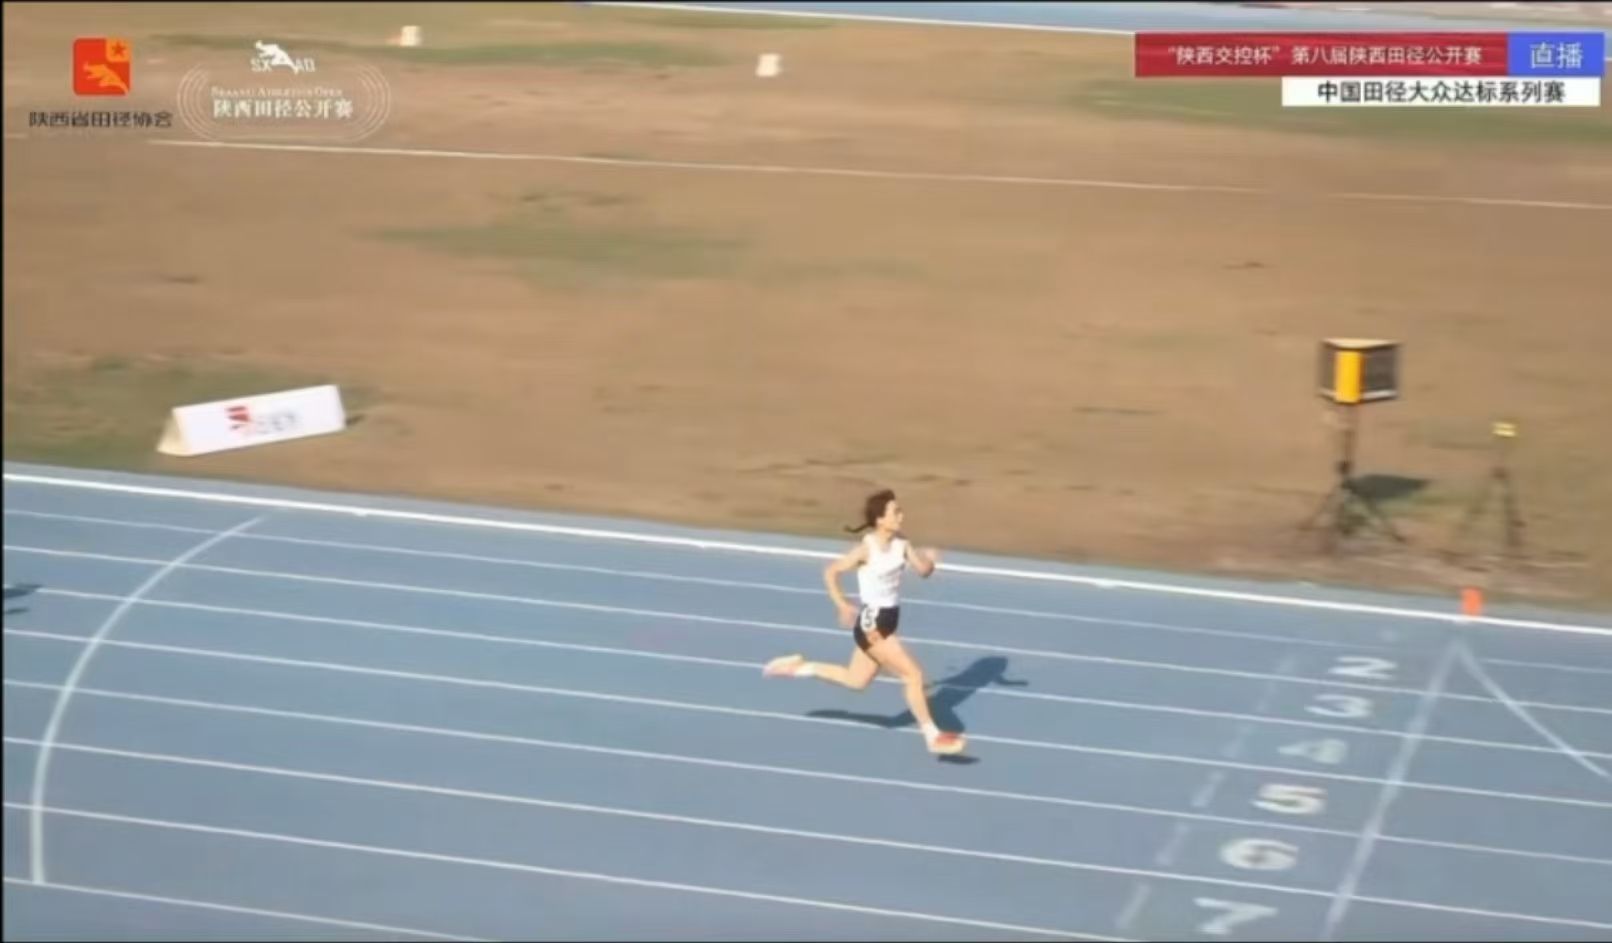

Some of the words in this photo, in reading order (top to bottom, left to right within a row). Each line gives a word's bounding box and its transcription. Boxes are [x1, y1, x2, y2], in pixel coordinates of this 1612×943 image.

[1328, 656, 1397, 680] 2
[1304, 694, 1373, 718] 3
[1277, 738, 1348, 765] 4
[1250, 783, 1328, 815] 5
[1219, 838, 1300, 870] 6
[1193, 898, 1279, 935] 7
